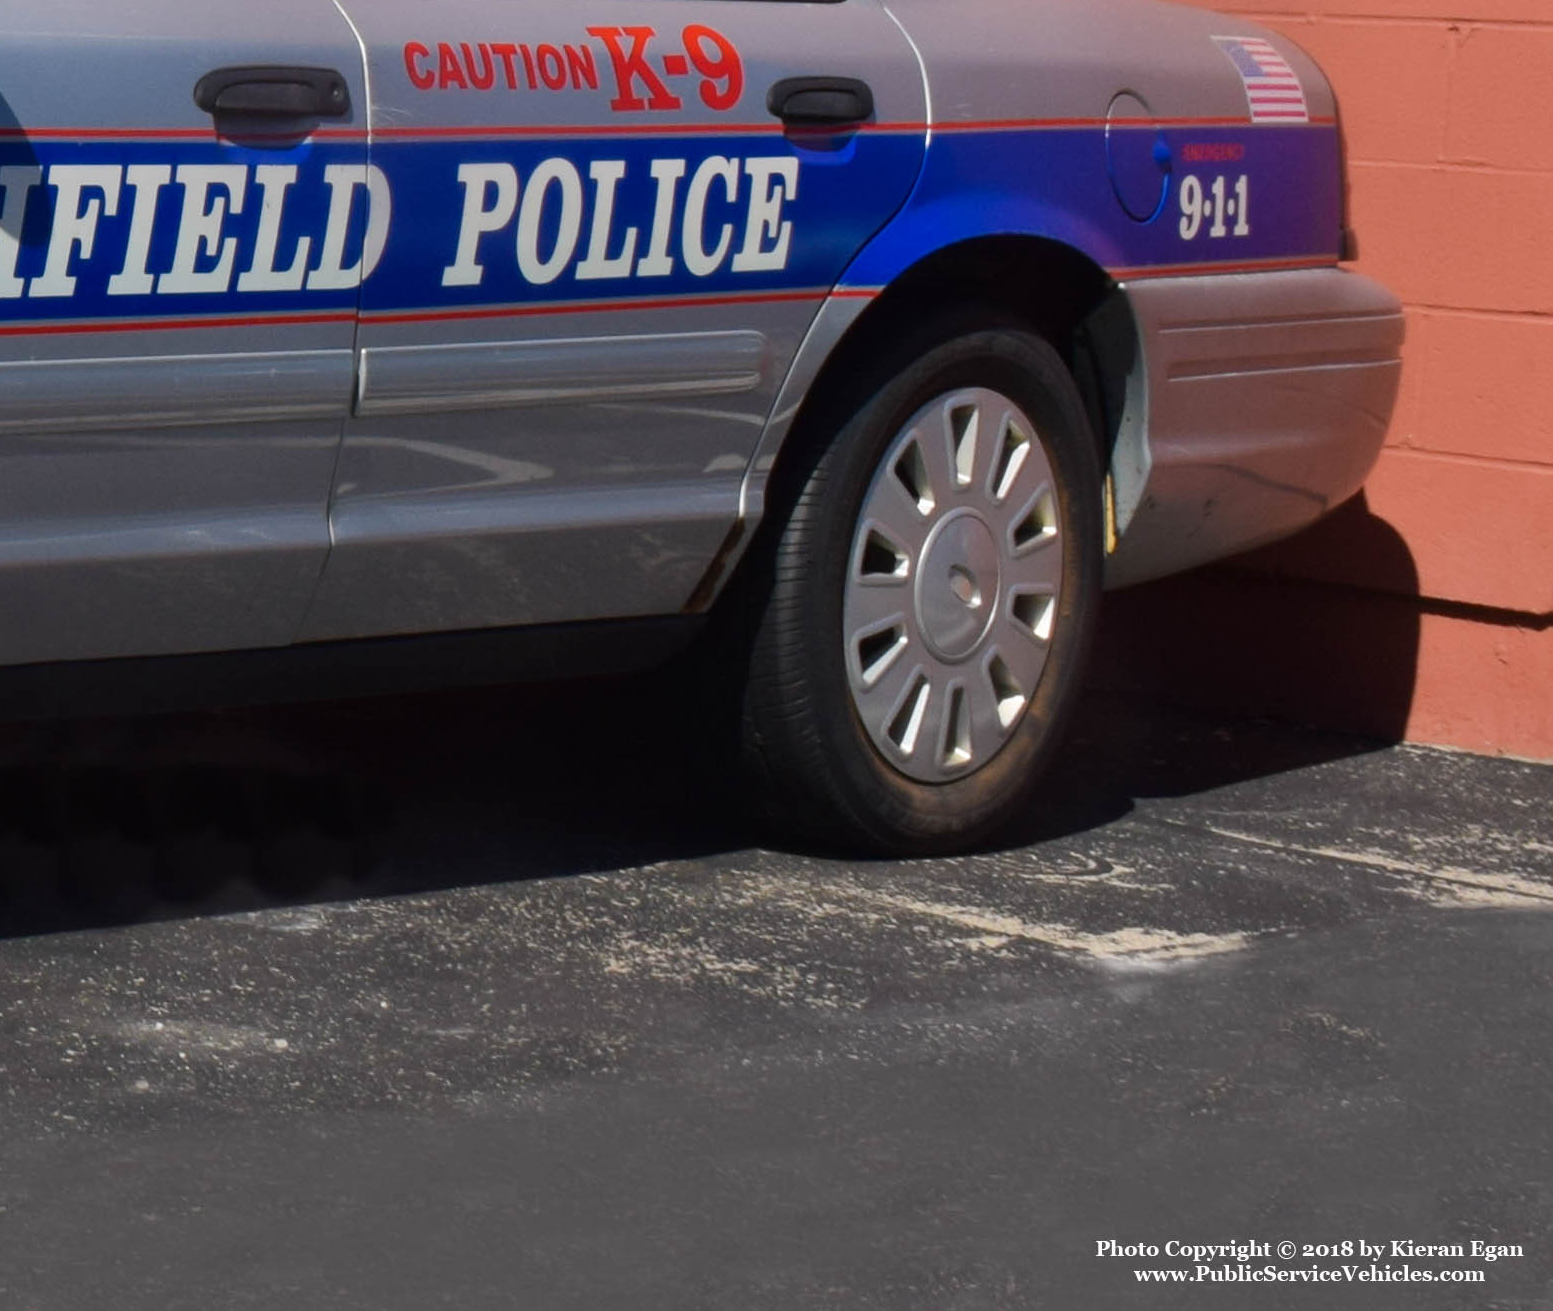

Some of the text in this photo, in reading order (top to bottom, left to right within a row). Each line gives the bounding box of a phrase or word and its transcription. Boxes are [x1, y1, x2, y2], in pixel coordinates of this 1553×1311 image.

[404, 23, 744, 111] CAUTION K-9
[442, 155, 800, 287] POLICE
